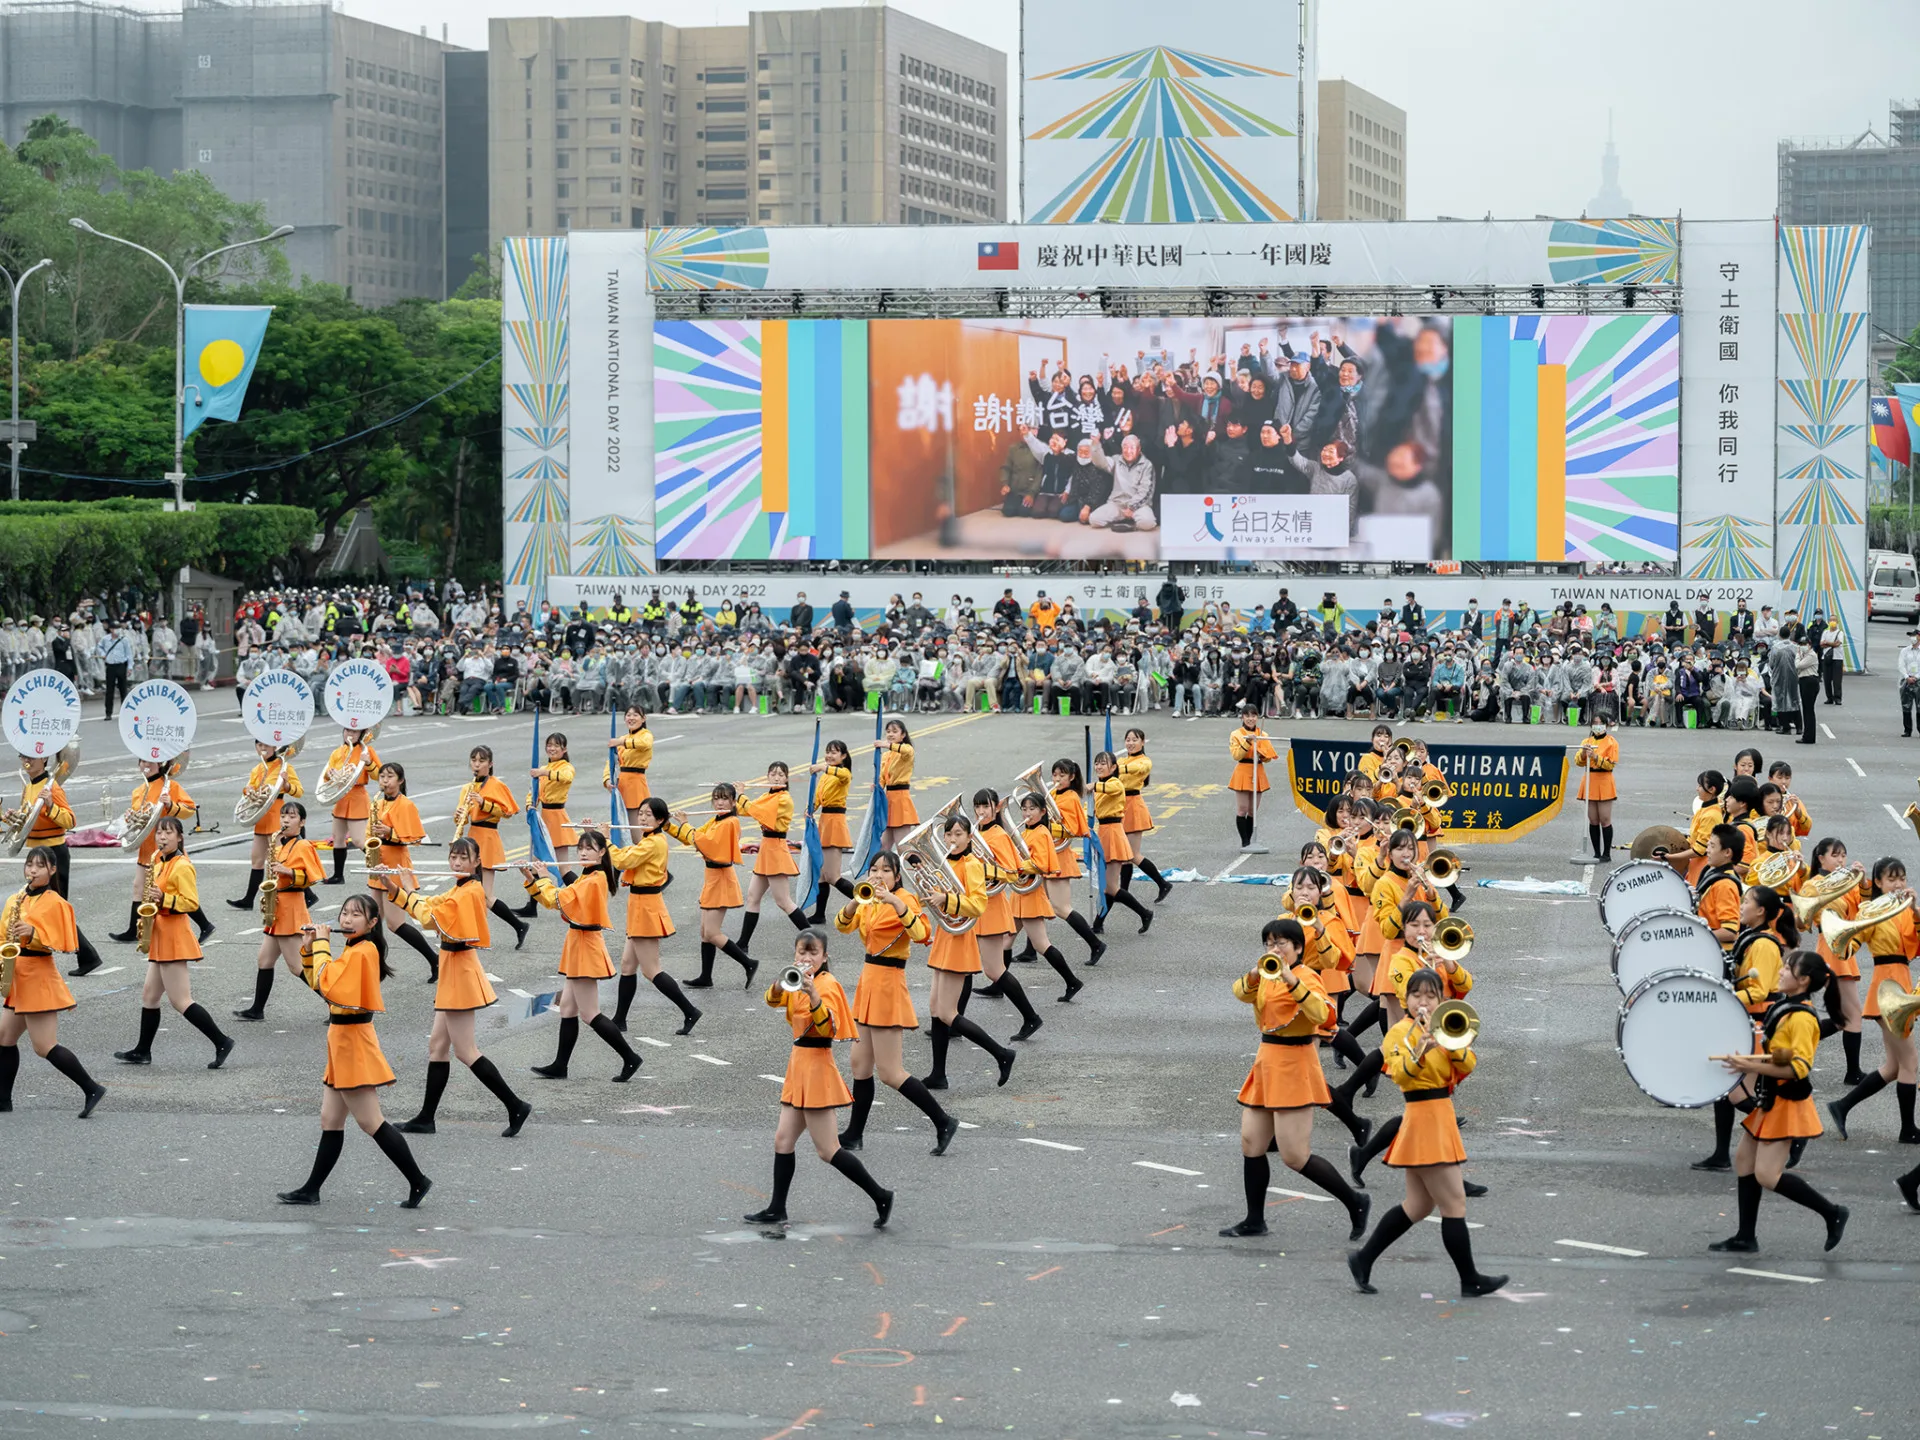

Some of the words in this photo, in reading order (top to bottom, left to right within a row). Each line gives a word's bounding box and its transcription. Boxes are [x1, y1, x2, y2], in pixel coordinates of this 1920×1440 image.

[1037, 242, 1332, 267] 慶祝中華民國一一一年國慶
[607, 269, 619, 325] TAIWAN
[1719, 262, 1740, 361] 守土衛國
[607, 329, 619, 401] NATIONAL
[608, 406, 619, 433] DAY
[1718, 383, 1739, 483] 你我同行
[607, 437, 620, 473] 2022
[1231, 510, 1313, 533] 台日友情
[1231, 535, 1275, 544] Always
[1285, 535, 1313, 543] Here
[575, 584, 626, 596] TAIWAN
[703, 584, 728, 596] DAY
[731, 584, 766, 596] 2022
[1083, 585, 1147, 598] 守土衛國
[1181, 585, 1224, 598] 我同行
[1551, 588, 1605, 599] TAIWAN
[1610, 588, 1681, 600] NATIONAL
[1686, 588, 1713, 600] DAY
[1717, 587, 1753, 600] 2022
[248, 673, 309, 701] TACHIBANA
[329, 664, 386, 691] TACHIBANA
[11, 675, 76, 707] TACHIBANA
[125, 685, 189, 715] TACHIBANA
[268, 709, 305, 721] 日台友情
[347, 697, 382, 710] 日台友情
[31, 717, 71, 730] 日台友情
[146, 724, 185, 738] 日台友情
[1312, 750, 1366, 773] KYO
[1427, 754, 1542, 777] CHIBANA
[1297, 776, 1341, 795] SENIO
[1450, 781, 1513, 798] SCHOOL
[1519, 784, 1559, 800] BAND
[1626, 870, 1664, 890] YAMAHA
[1653, 926, 1694, 941] YAMAHA
[1671, 991, 1718, 1004] YAMAHA
